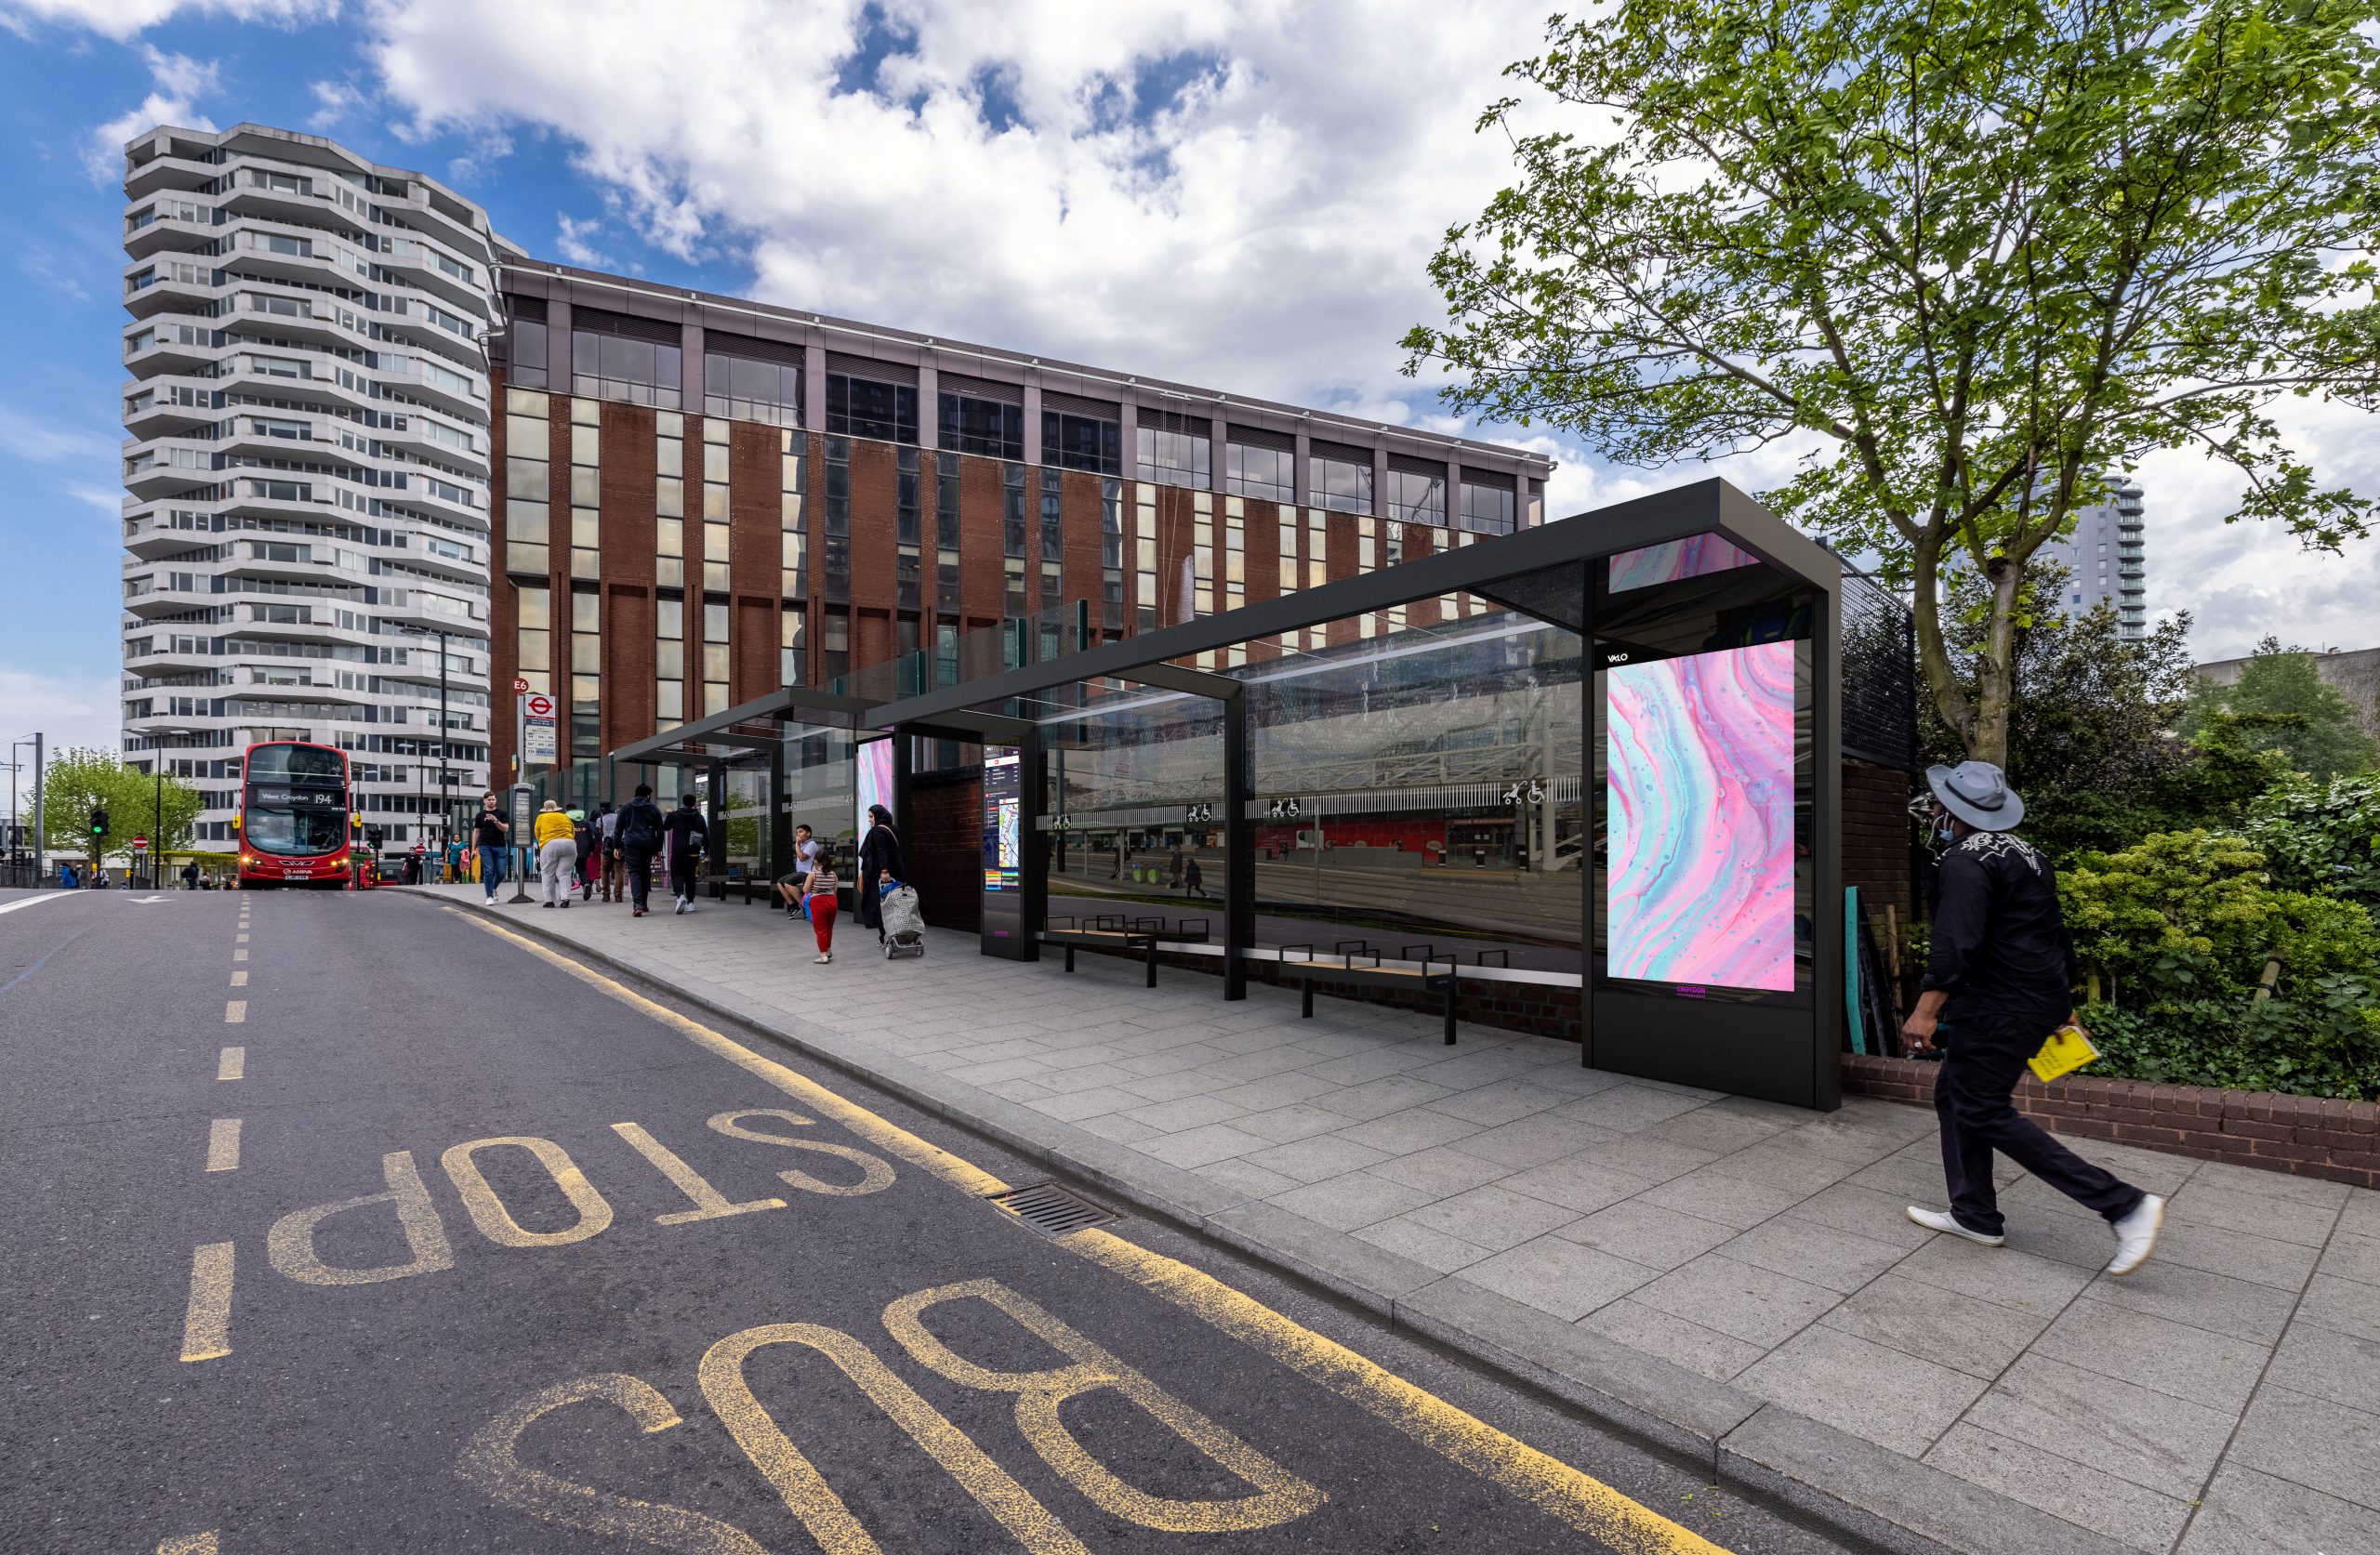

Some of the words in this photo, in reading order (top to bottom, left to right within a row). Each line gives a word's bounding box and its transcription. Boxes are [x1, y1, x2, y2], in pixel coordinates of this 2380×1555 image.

[316, 794, 332, 804] 194
[1676, 985, 1706, 994] CROYDON
[267, 1107, 898, 1286] STOP
[455, 1279, 1331, 1555] BUS
